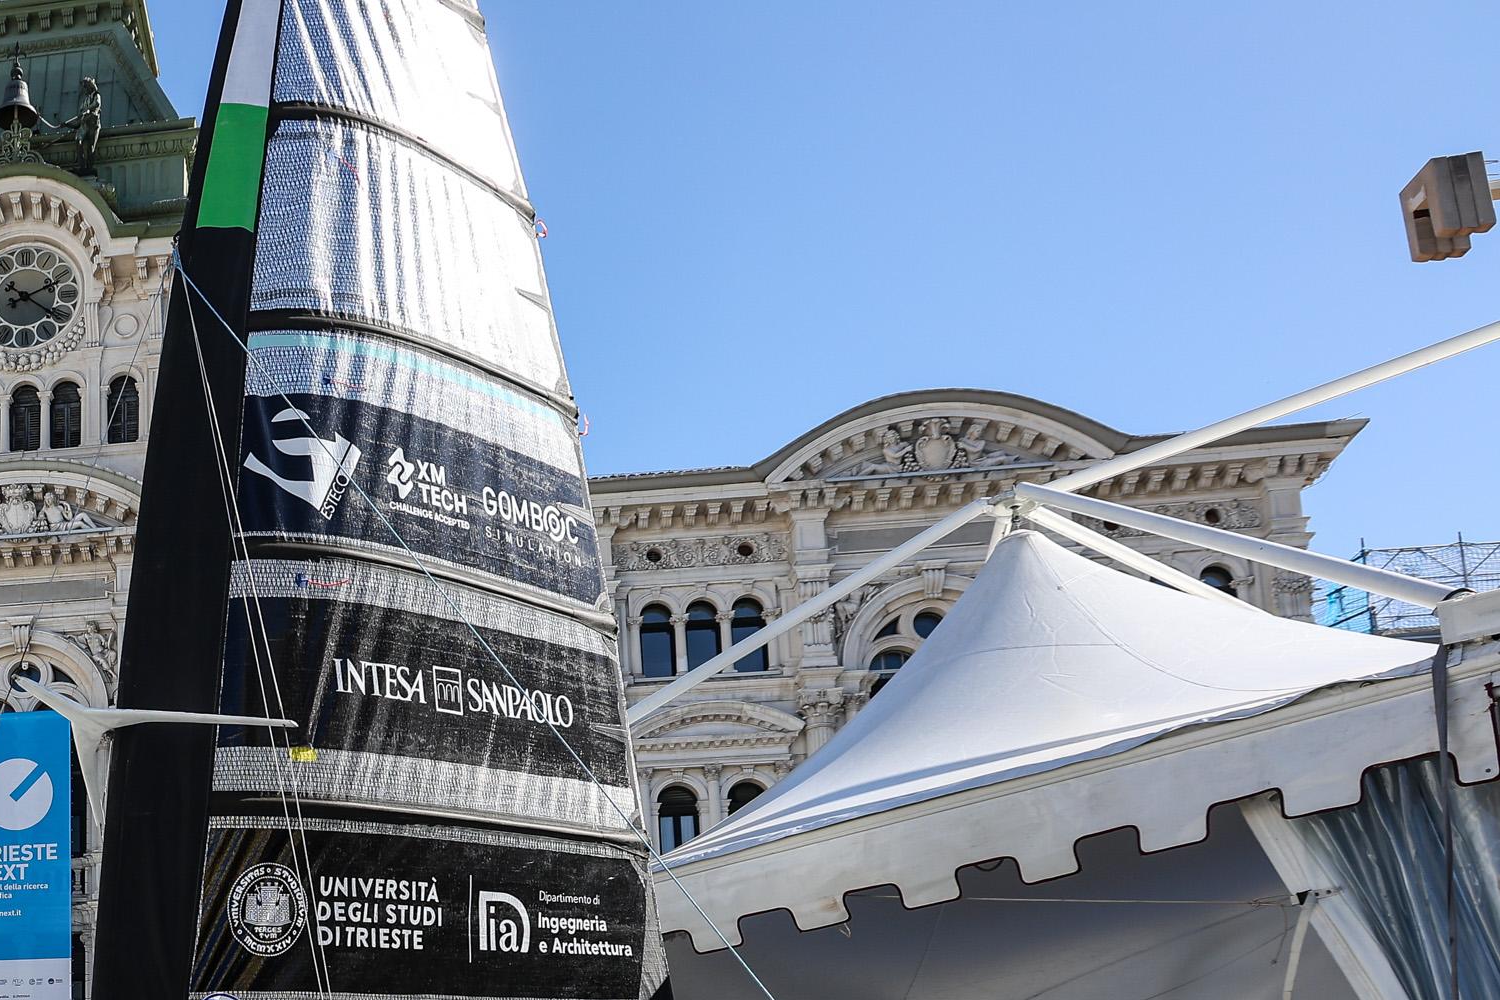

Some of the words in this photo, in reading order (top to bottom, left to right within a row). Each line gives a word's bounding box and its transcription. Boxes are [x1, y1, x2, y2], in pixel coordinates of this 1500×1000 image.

[417, 459, 446, 486] XM
[320, 474, 350, 520] ESTECO
[418, 484, 467, 514] TECH
[390, 502, 433, 519] CHALLENGE
[434, 513, 470, 530] ACCEPTED
[486, 526, 581, 566] SIMULATION
[333, 658, 427, 704] INTESA
[466, 679, 573, 728] SANPAOLO
[320, 876, 440, 902] UNIVERSITÀ
[539, 890, 591, 904] Dipartimento
[593, 894, 600, 905] di
[318, 901, 378, 923] DEGLI
[386, 904, 442, 926] STUDI
[538, 912, 608, 934] Ingegneria
[318, 926, 340, 946] DI
[346, 926, 424, 950] TRIESTE
[538, 941, 548, 952] e
[552, 938, 632, 956] Architettura
